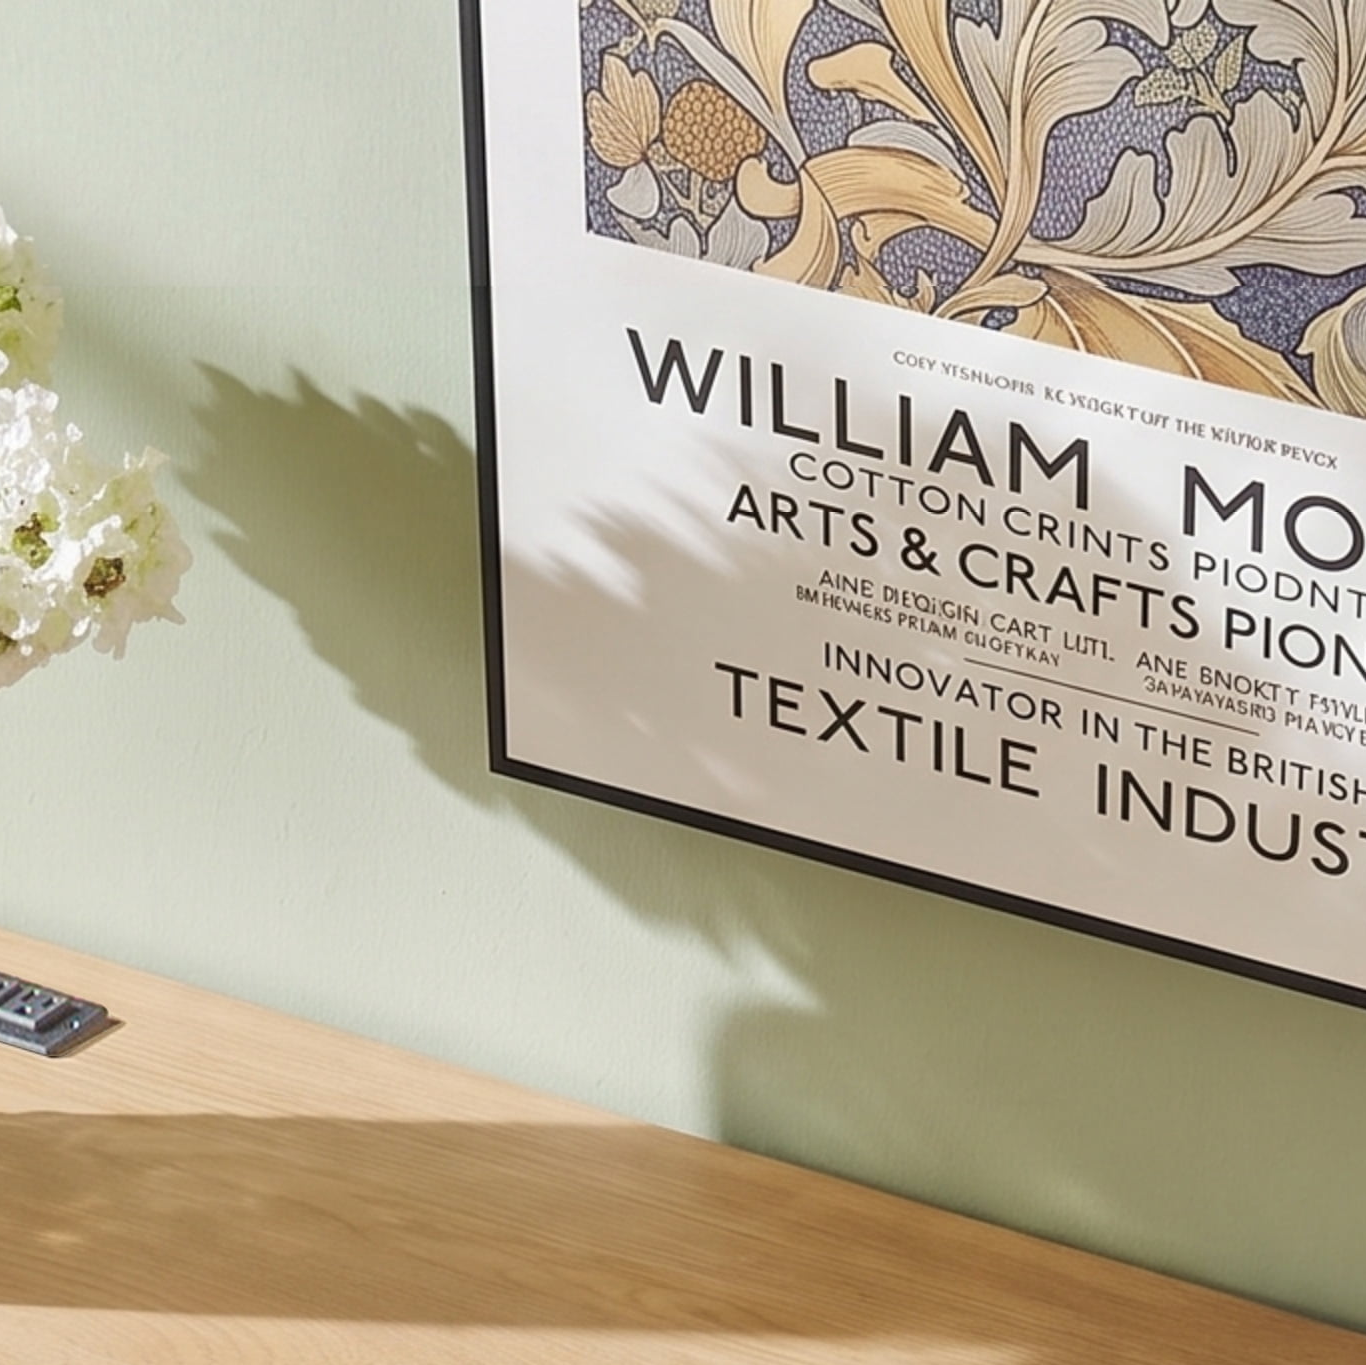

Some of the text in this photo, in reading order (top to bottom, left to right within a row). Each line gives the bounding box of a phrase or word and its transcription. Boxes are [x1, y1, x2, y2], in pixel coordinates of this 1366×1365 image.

[626, 327, 1090, 511] WILLIAM
[1175, 418, 1206, 439] THE
[727, 484, 878, 557] ARTS
[900, 527, 941, 577] &
[958, 543, 1200, 639] CRAFTS
[789, 452, 985, 526] COTTON
[1004, 506, 1170, 571] CRINTS
[990, 613, 1051, 643] CART
[1136, 651, 1187, 679] ANE
[714, 662, 1039, 798] TEXTILE
[824, 641, 1062, 729] INNOVATOR
[1082, 708, 1119, 743] IN
[1135, 722, 1212, 767] THE
